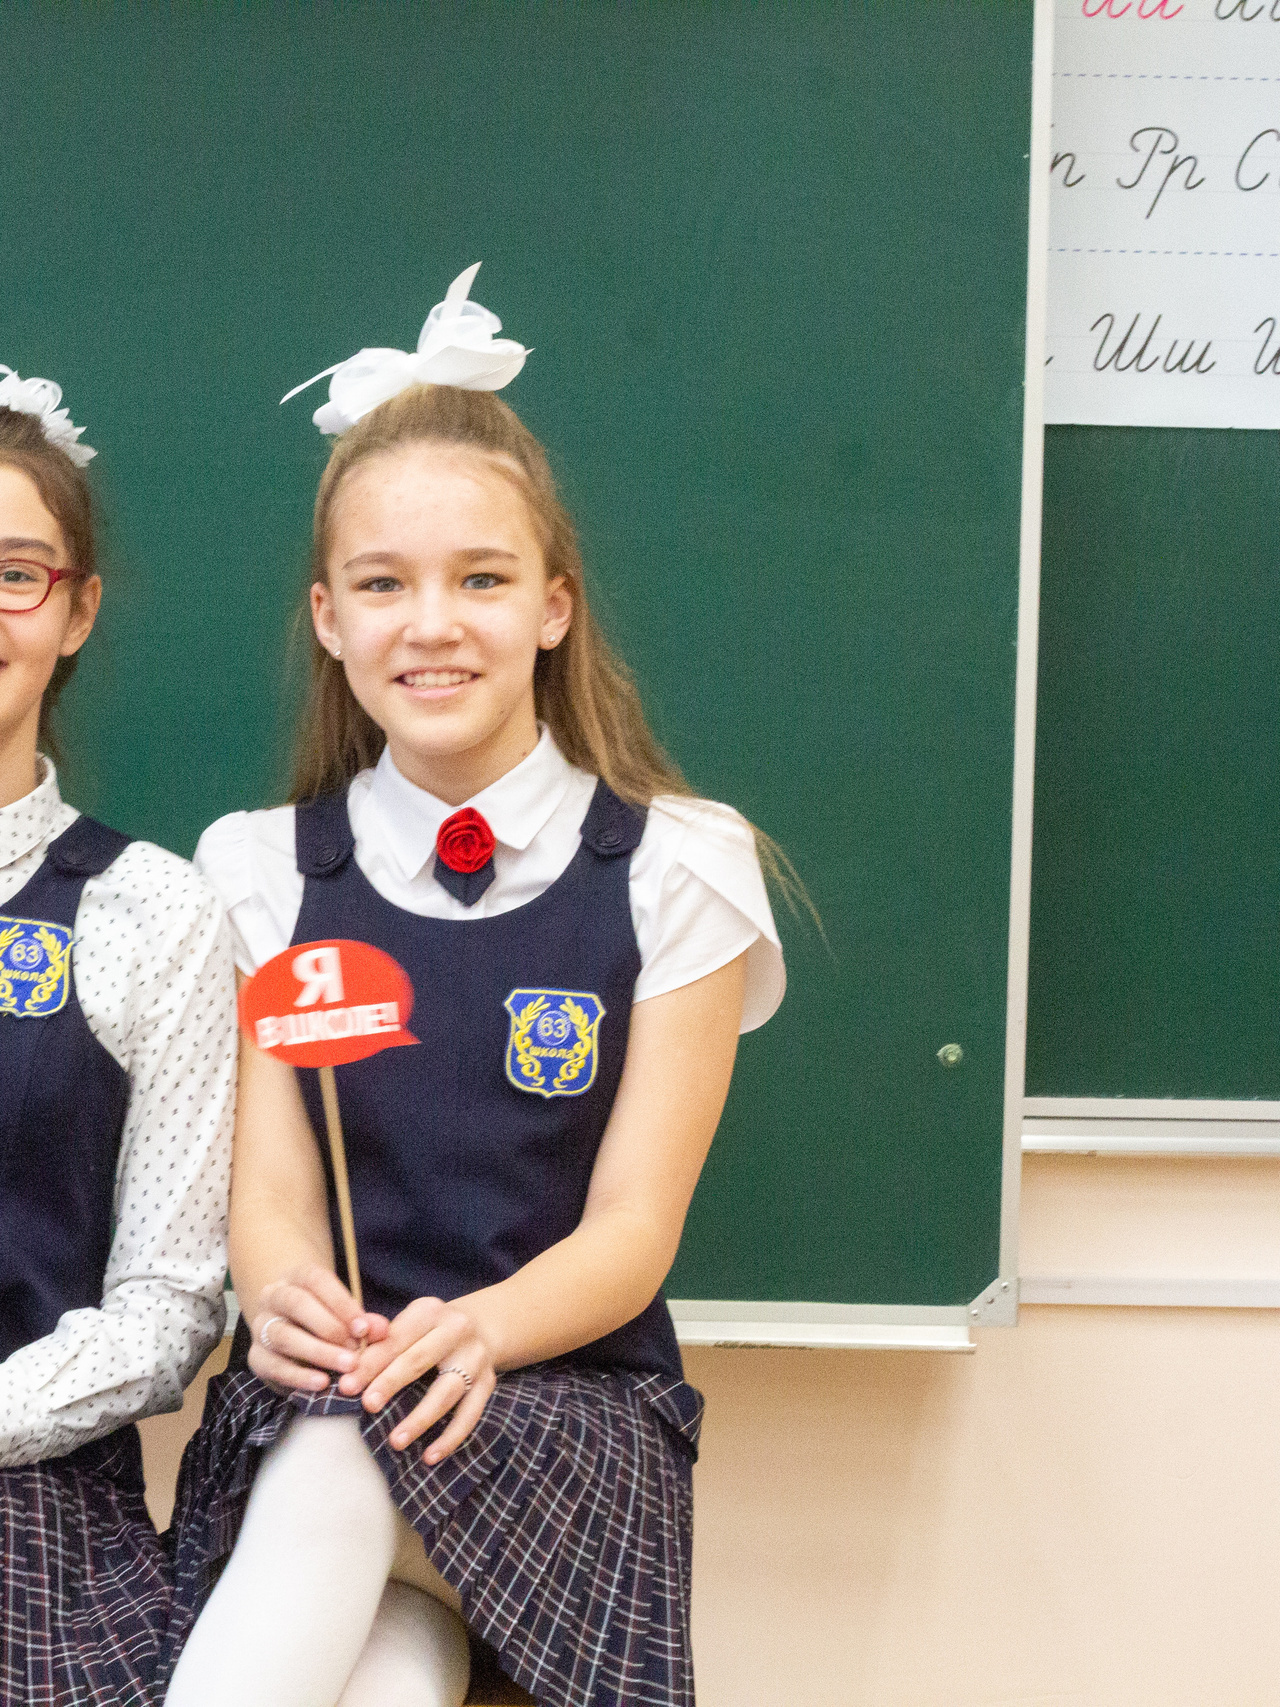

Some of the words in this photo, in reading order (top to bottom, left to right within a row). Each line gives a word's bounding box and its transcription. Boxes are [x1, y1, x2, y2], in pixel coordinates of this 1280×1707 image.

[1050, 150, 1086, 188] п
[1116, 126, 1206, 220] Рр
[1235, 128, 1280, 192] С
[1090, 312, 1217, 374] Шш
[13, 943, 40, 963] 63
[291, 946, 346, 1008] Я
[540, 1016, 567, 1038] 63
